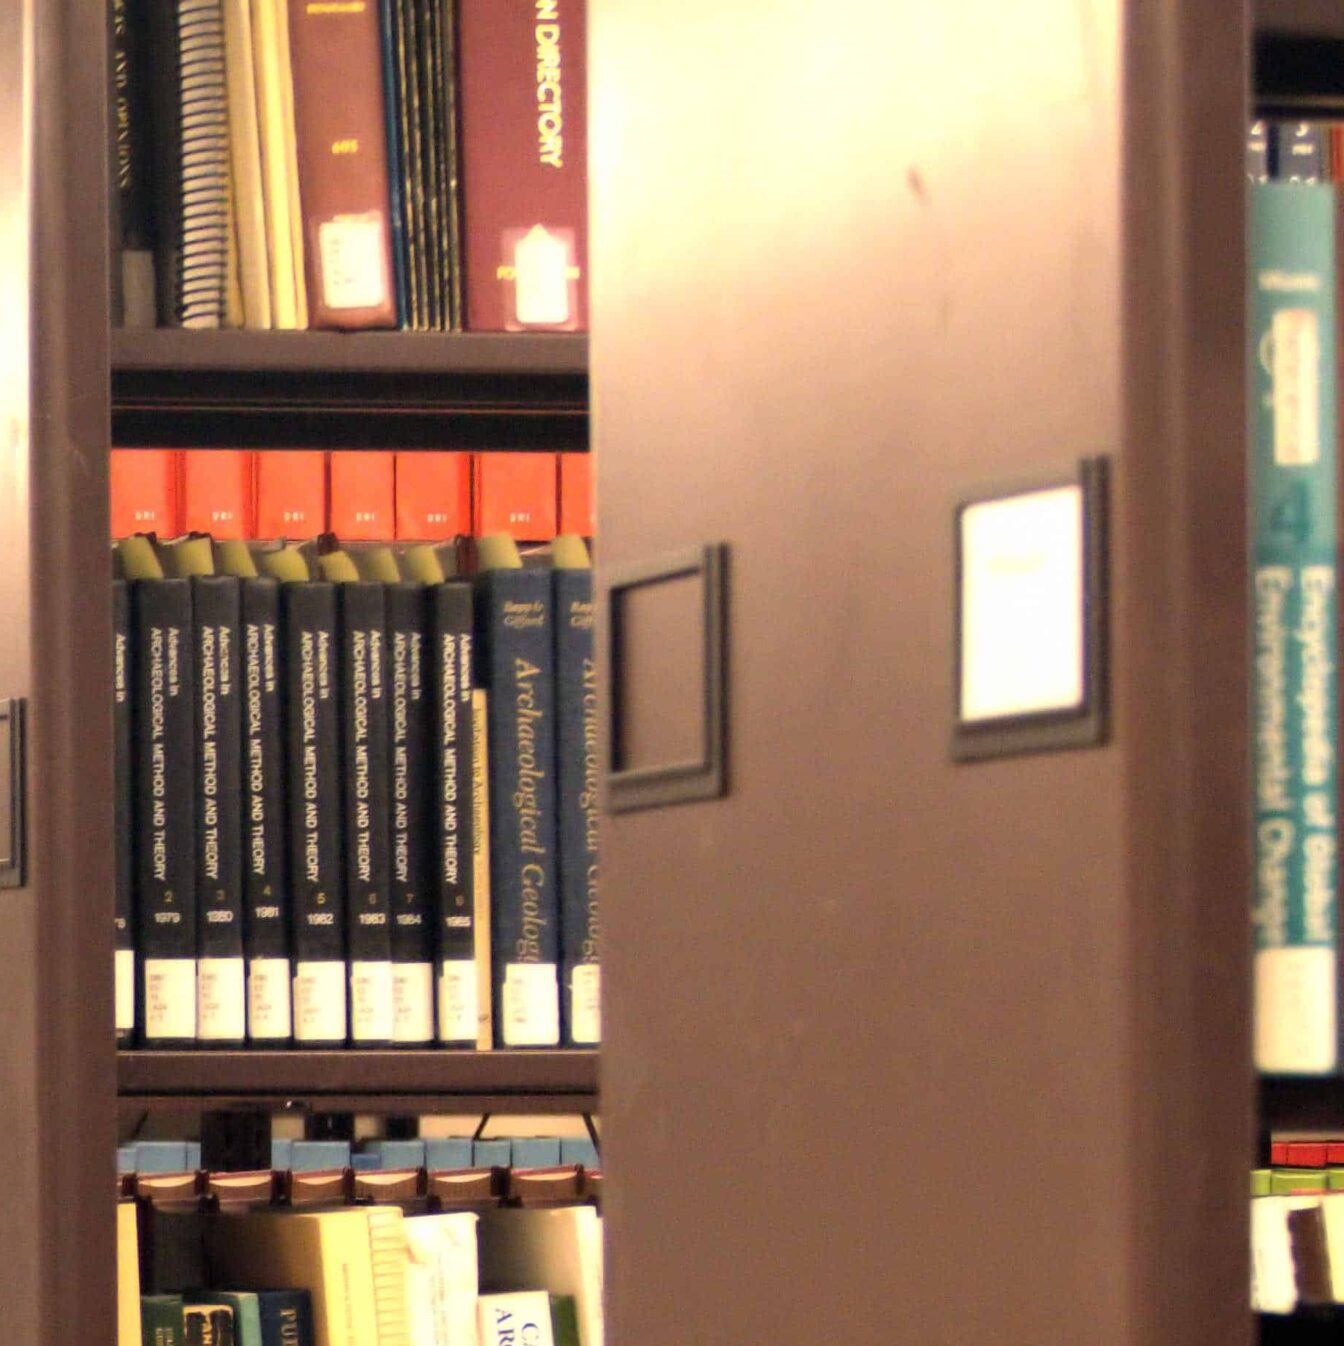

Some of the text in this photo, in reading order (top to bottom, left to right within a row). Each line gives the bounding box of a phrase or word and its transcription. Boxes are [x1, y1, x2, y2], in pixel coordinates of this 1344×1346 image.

[535, 24, 564, 169] DIRECTORY
[169, 627, 180, 696] Advances in
[220, 627, 231, 694] Advances in
[264, 624, 275, 691] Advances in
[318, 631, 330, 698] Advances in
[371, 631, 383, 698] Advances in
[411, 633, 422, 700] Advances in
[459, 634, 471, 701] Advances in
[151, 627, 165, 880] ARCHAEOLOGICAL METHOD AND THEORY
[203, 627, 218, 879] ARCHAEOLOGICAL METHOD AND THEORY
[247, 624, 264, 874] ARCHAEOLOGICAL METHOD AND THEORY
[302, 631, 318, 882] ARCHAEOLOGICAL METHOD AND THEORY
[353, 631, 369, 882] ARCHAEOLOGICAL METHOD AND THEORY
[394, 632, 408, 882] ARCHAEOLOGICAL METHOD AND THEORY
[443, 634, 457, 884] ARCHAEOLOGICAL METHOD AND THEORY
[512, 658, 546, 853] Archaeological
[317, 894, 325, 904] 5
